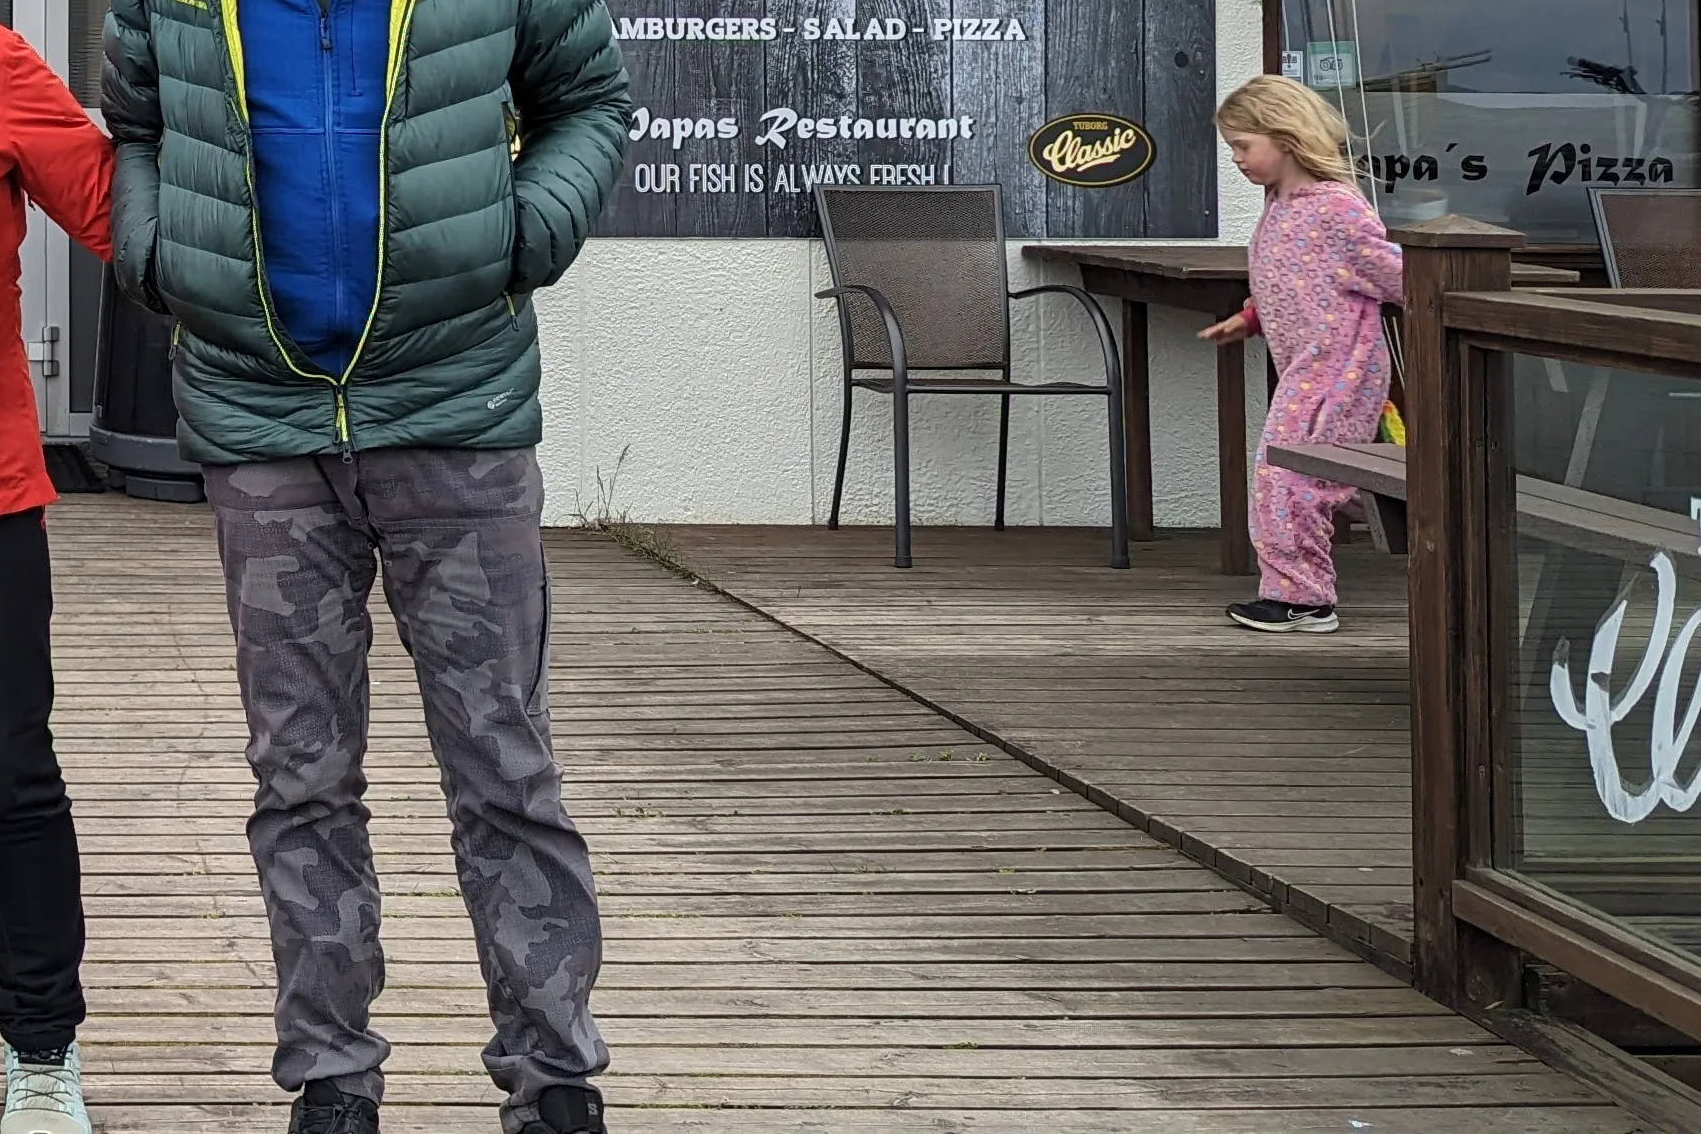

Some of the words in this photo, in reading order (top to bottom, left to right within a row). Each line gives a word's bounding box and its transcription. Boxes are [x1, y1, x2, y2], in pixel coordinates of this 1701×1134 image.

[803, 18, 907, 40] SALAD
[934, 18, 1026, 40] PIZZA
[754, 107, 974, 150] Restaurant
[1073, 122, 1108, 130] TUBORG
[1043, 128, 1136, 172] Classic
[635, 164, 680, 193] OUR
[689, 164, 735, 193] FISH
[744, 164, 763, 193] IS
[774, 164, 861, 193] ALWAYS
[870, 164, 935, 185] FRESH
[1340, 143, 1488, 194] apa's
[1526, 143, 1673, 196] Pizza
